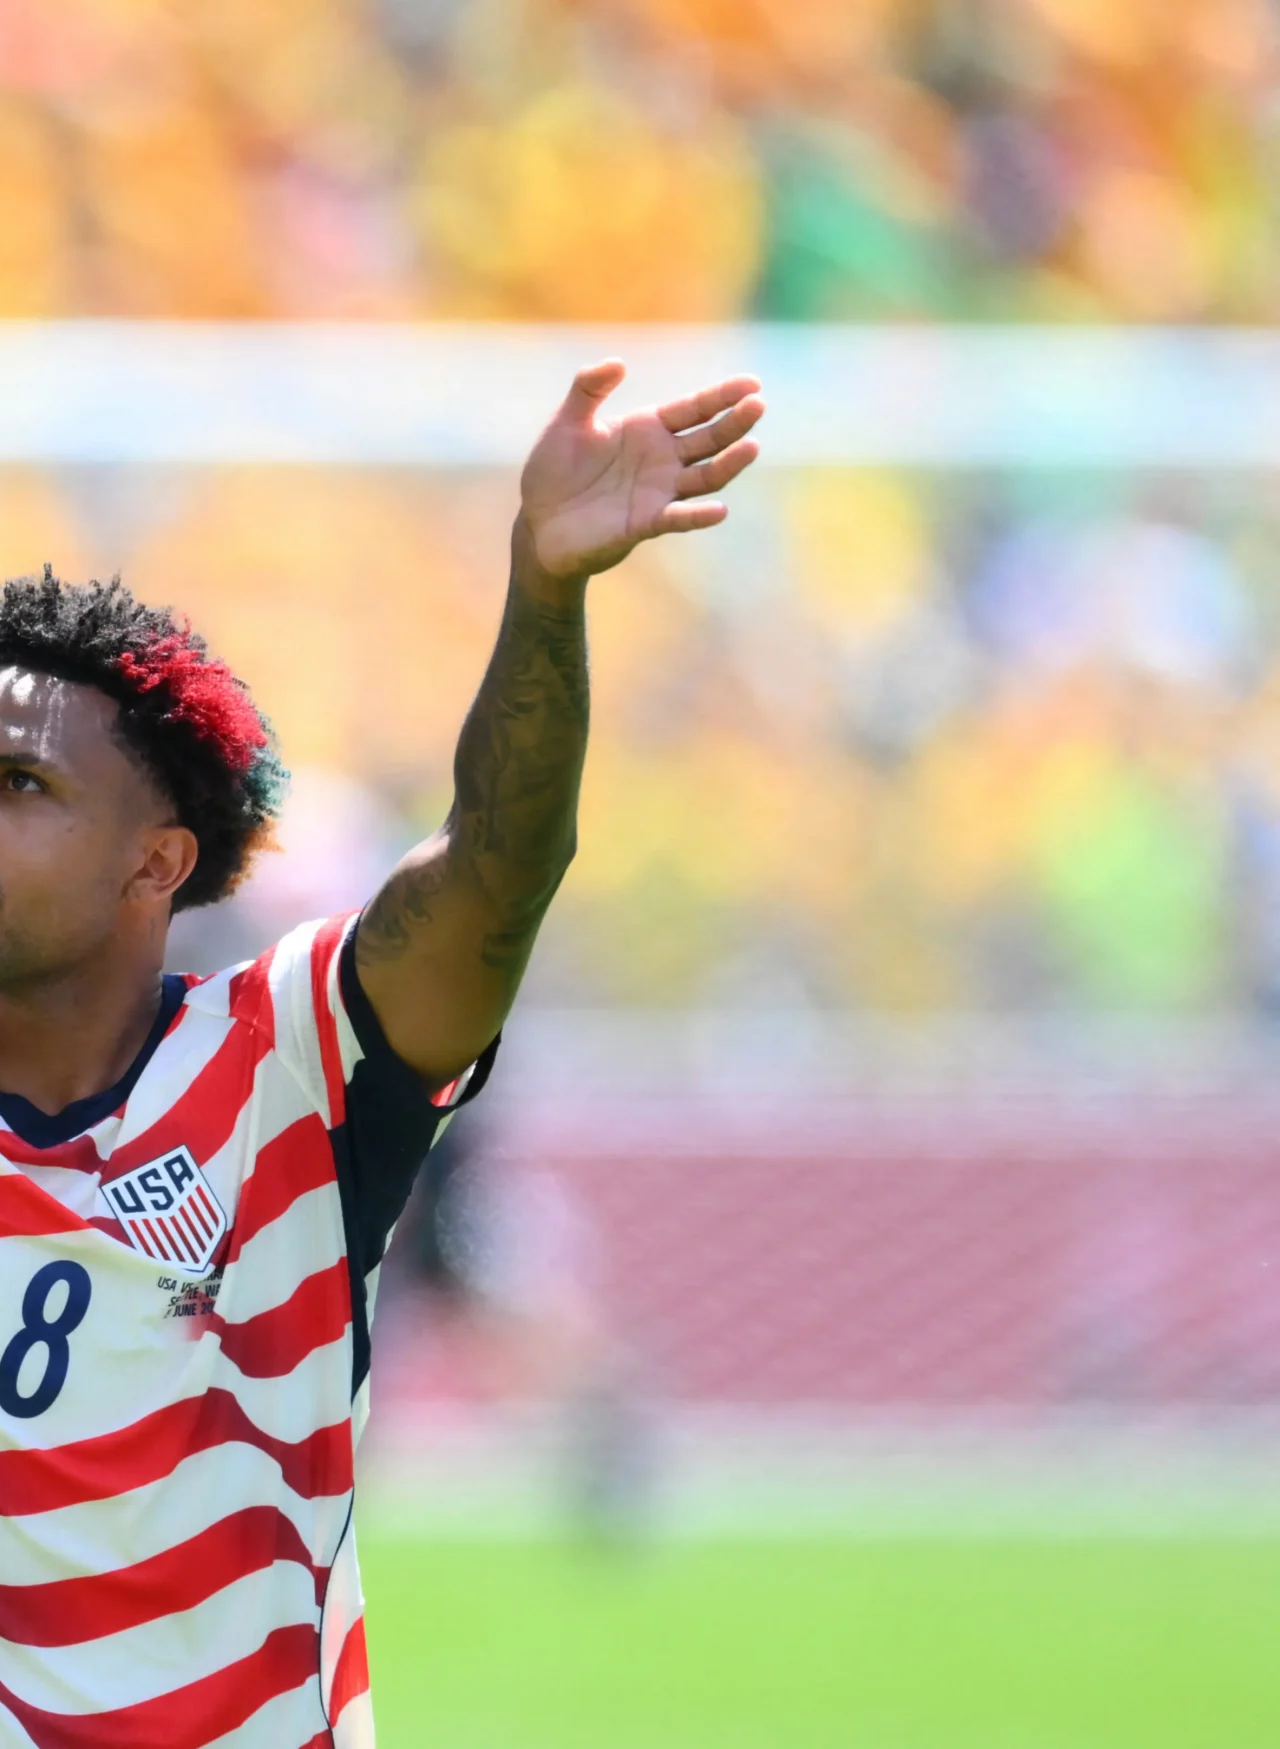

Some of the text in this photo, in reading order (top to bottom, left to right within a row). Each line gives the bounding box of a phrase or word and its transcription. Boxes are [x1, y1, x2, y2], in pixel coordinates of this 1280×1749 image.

[110, 1153, 195, 1214] USA
[157, 1276, 178, 1292] USA
[172, 1302, 197, 1317] JUNE
